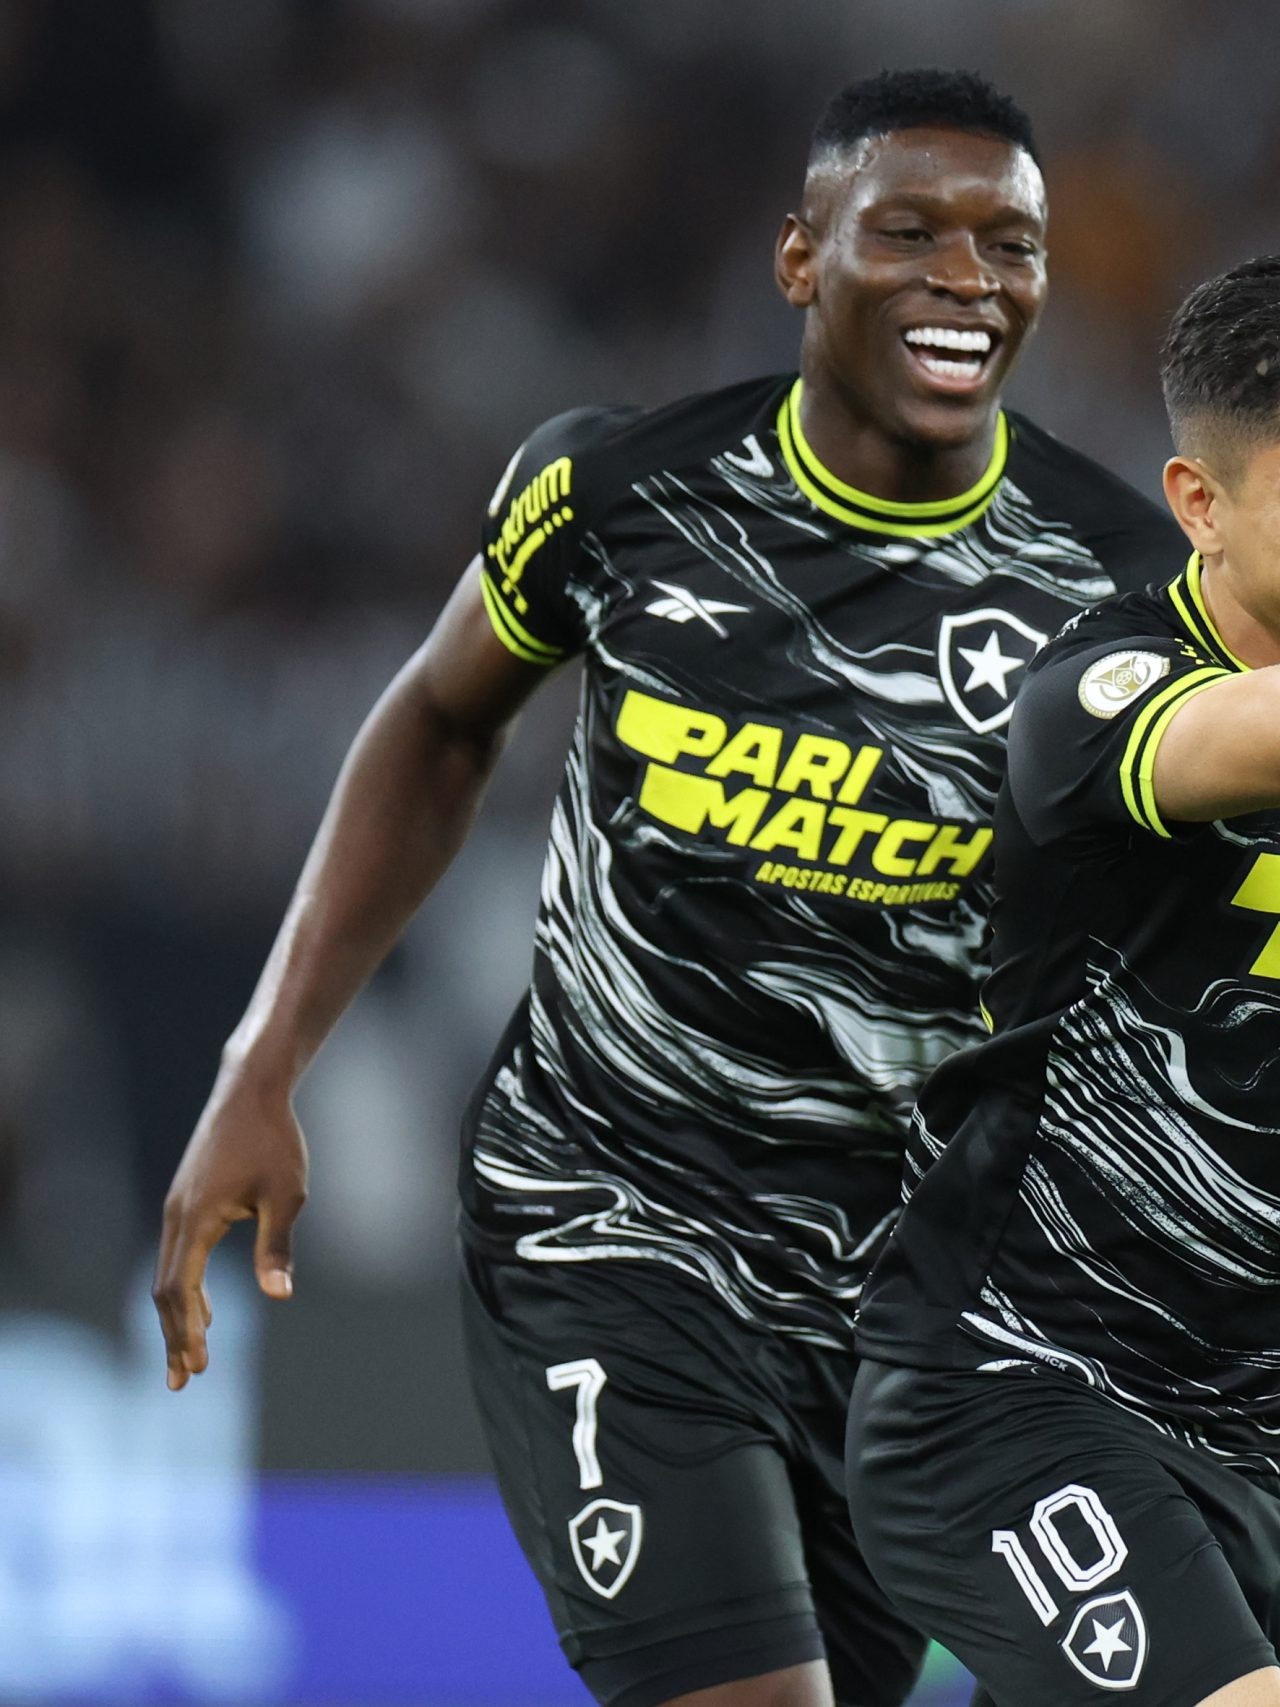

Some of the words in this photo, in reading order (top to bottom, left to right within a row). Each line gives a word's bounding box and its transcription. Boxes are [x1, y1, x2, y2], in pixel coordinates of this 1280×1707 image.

[616, 689, 884, 806] PARI
[638, 761, 995, 878] MATCH
[754, 861, 846, 897] APOSTAS
[845, 876, 962, 906] ESPORTIVAS
[545, 1357, 608, 1490] 7
[991, 1483, 1129, 1628] 10
